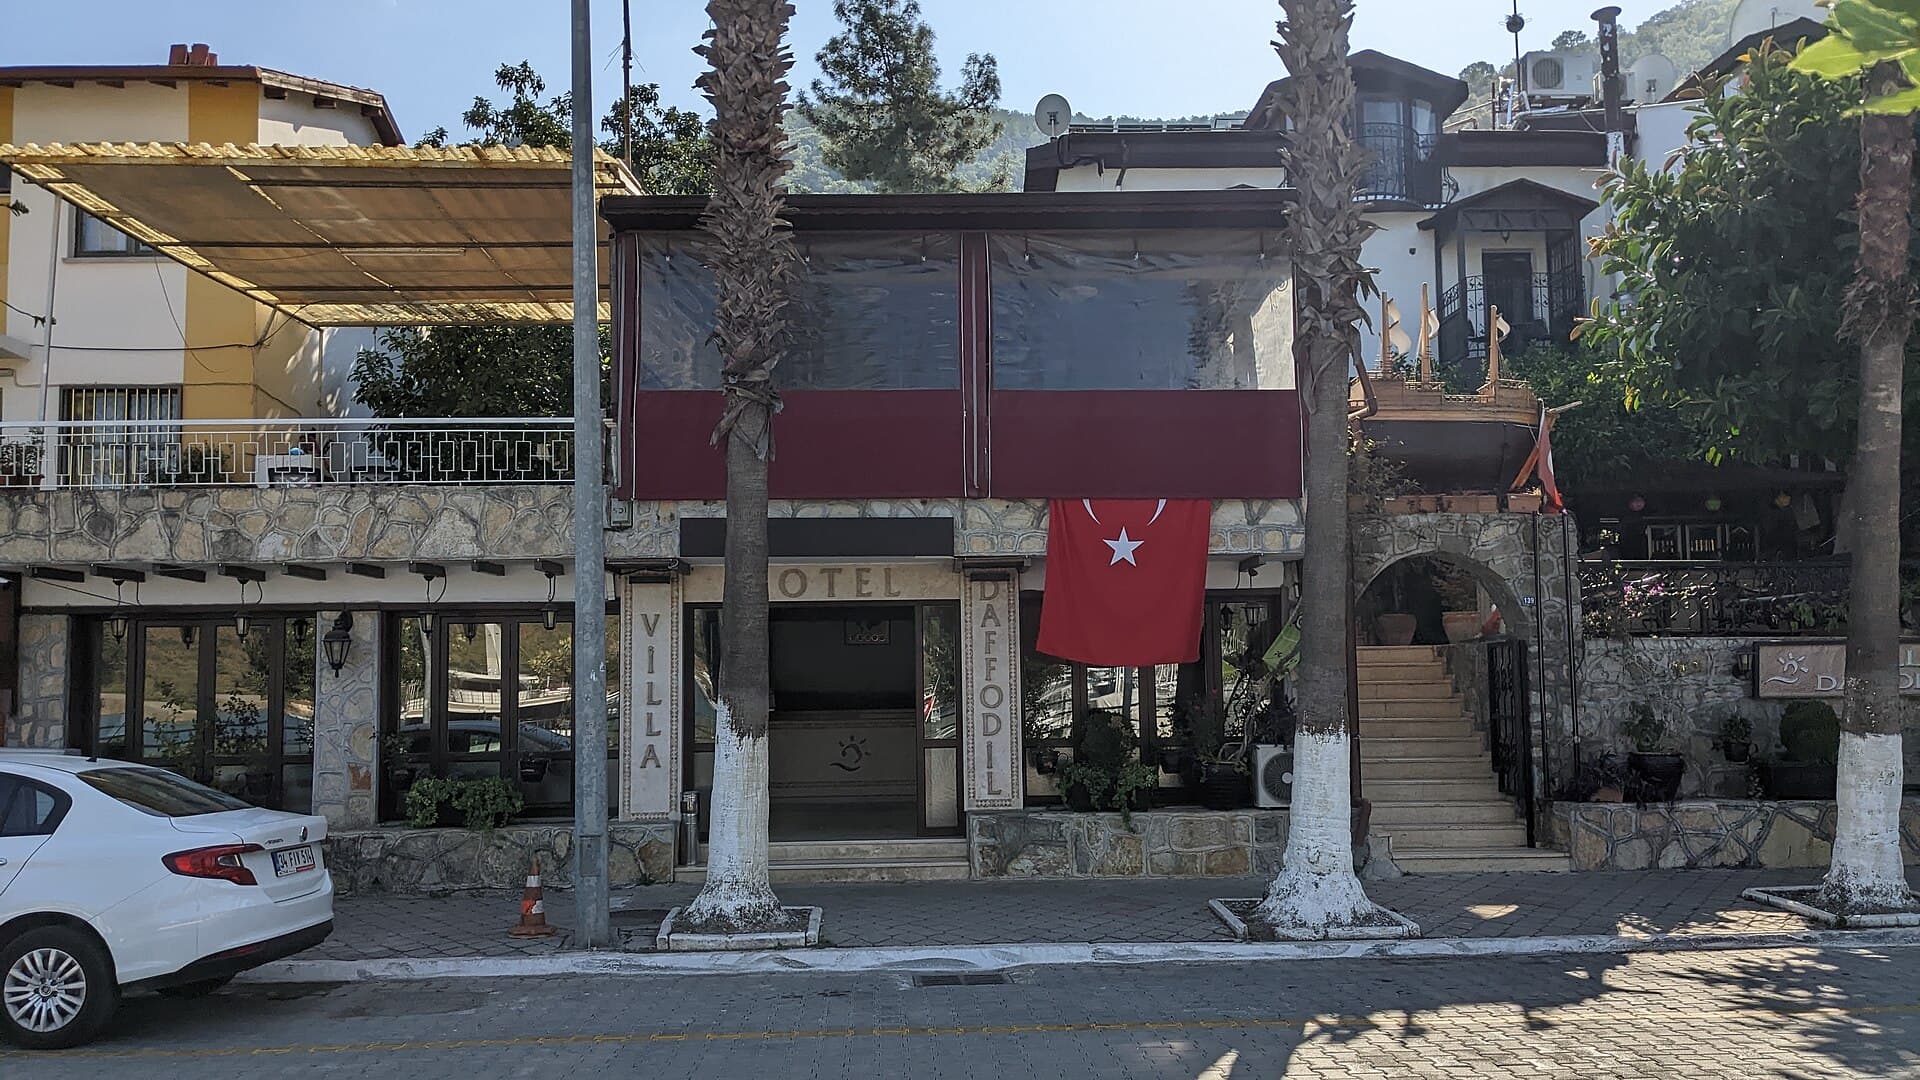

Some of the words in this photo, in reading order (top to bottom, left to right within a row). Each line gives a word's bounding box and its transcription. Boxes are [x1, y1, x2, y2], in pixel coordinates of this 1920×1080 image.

[778, 567, 901, 599] OTEL
[639, 613, 662, 769] VILLA
[979, 580, 1004, 796] DAFFODIL
[279, 853, 288, 869] 34
